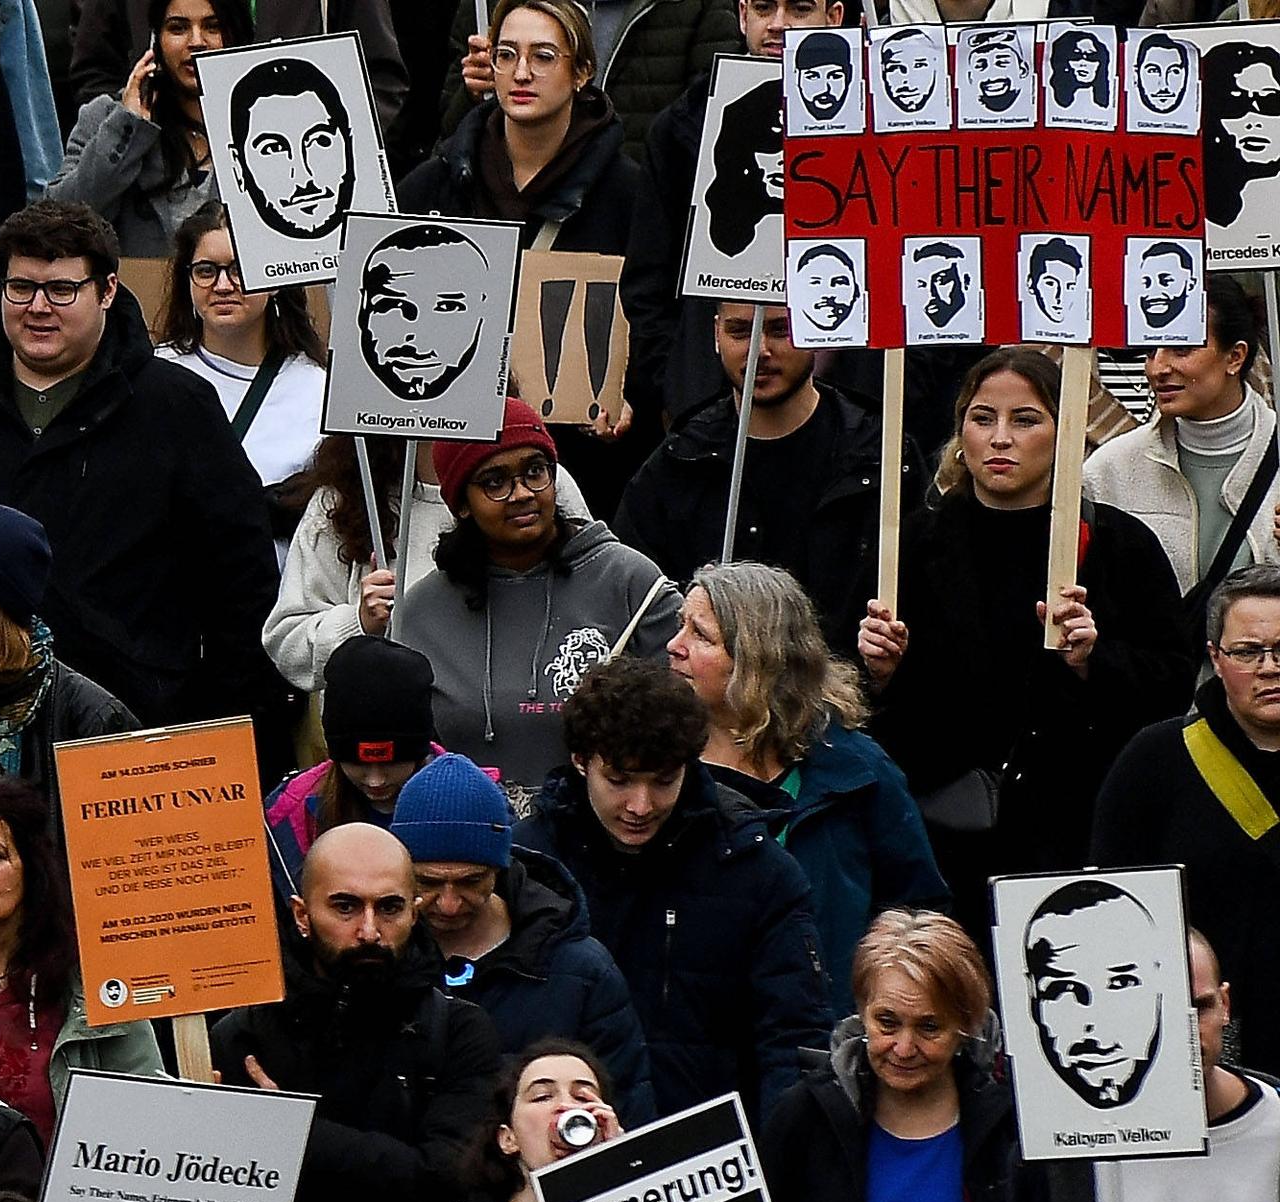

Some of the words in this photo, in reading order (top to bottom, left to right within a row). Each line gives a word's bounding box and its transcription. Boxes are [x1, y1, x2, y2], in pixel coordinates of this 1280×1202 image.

[1065, 143, 1201, 230] NAMES
[264, 260, 320, 278] Gökhan
[697, 273, 768, 291] Mercedes
[356, 413, 415, 429] Kaloyan
[418, 416, 468, 431] Velkov
[80, 792, 167, 821] FERHAT
[172, 782, 246, 809] UNVAR
[72, 1142, 161, 1178] Mario
[166, 1152, 281, 1189] Jödecke
